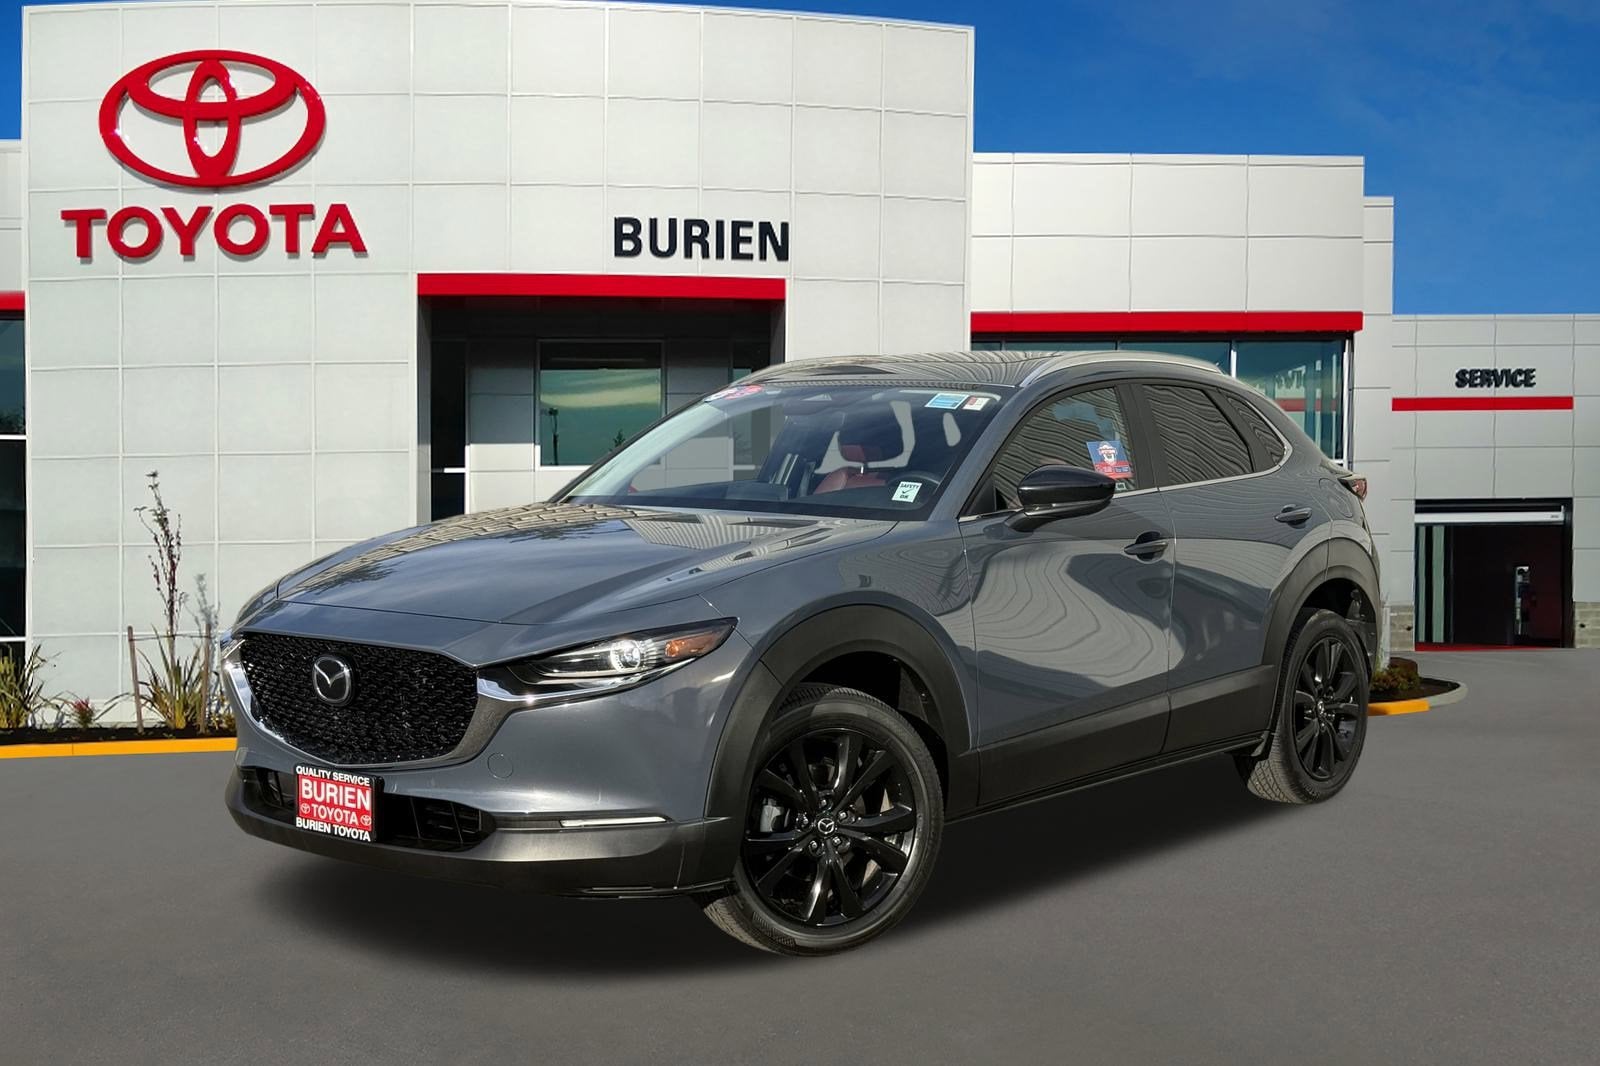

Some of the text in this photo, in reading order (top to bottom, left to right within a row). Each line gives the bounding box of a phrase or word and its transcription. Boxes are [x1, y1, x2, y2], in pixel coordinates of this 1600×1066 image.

[60, 203, 368, 260] TOYOTA
[614, 216, 790, 261] BURIEN
[1455, 368, 1536, 388] SERVICE
[296, 766, 370, 786] QUALITY SERVICE
[302, 778, 370, 811] BURIEN
[311, 803, 358, 825] TOYOTA
[296, 817, 371, 842] BURIEN TOYOTA
